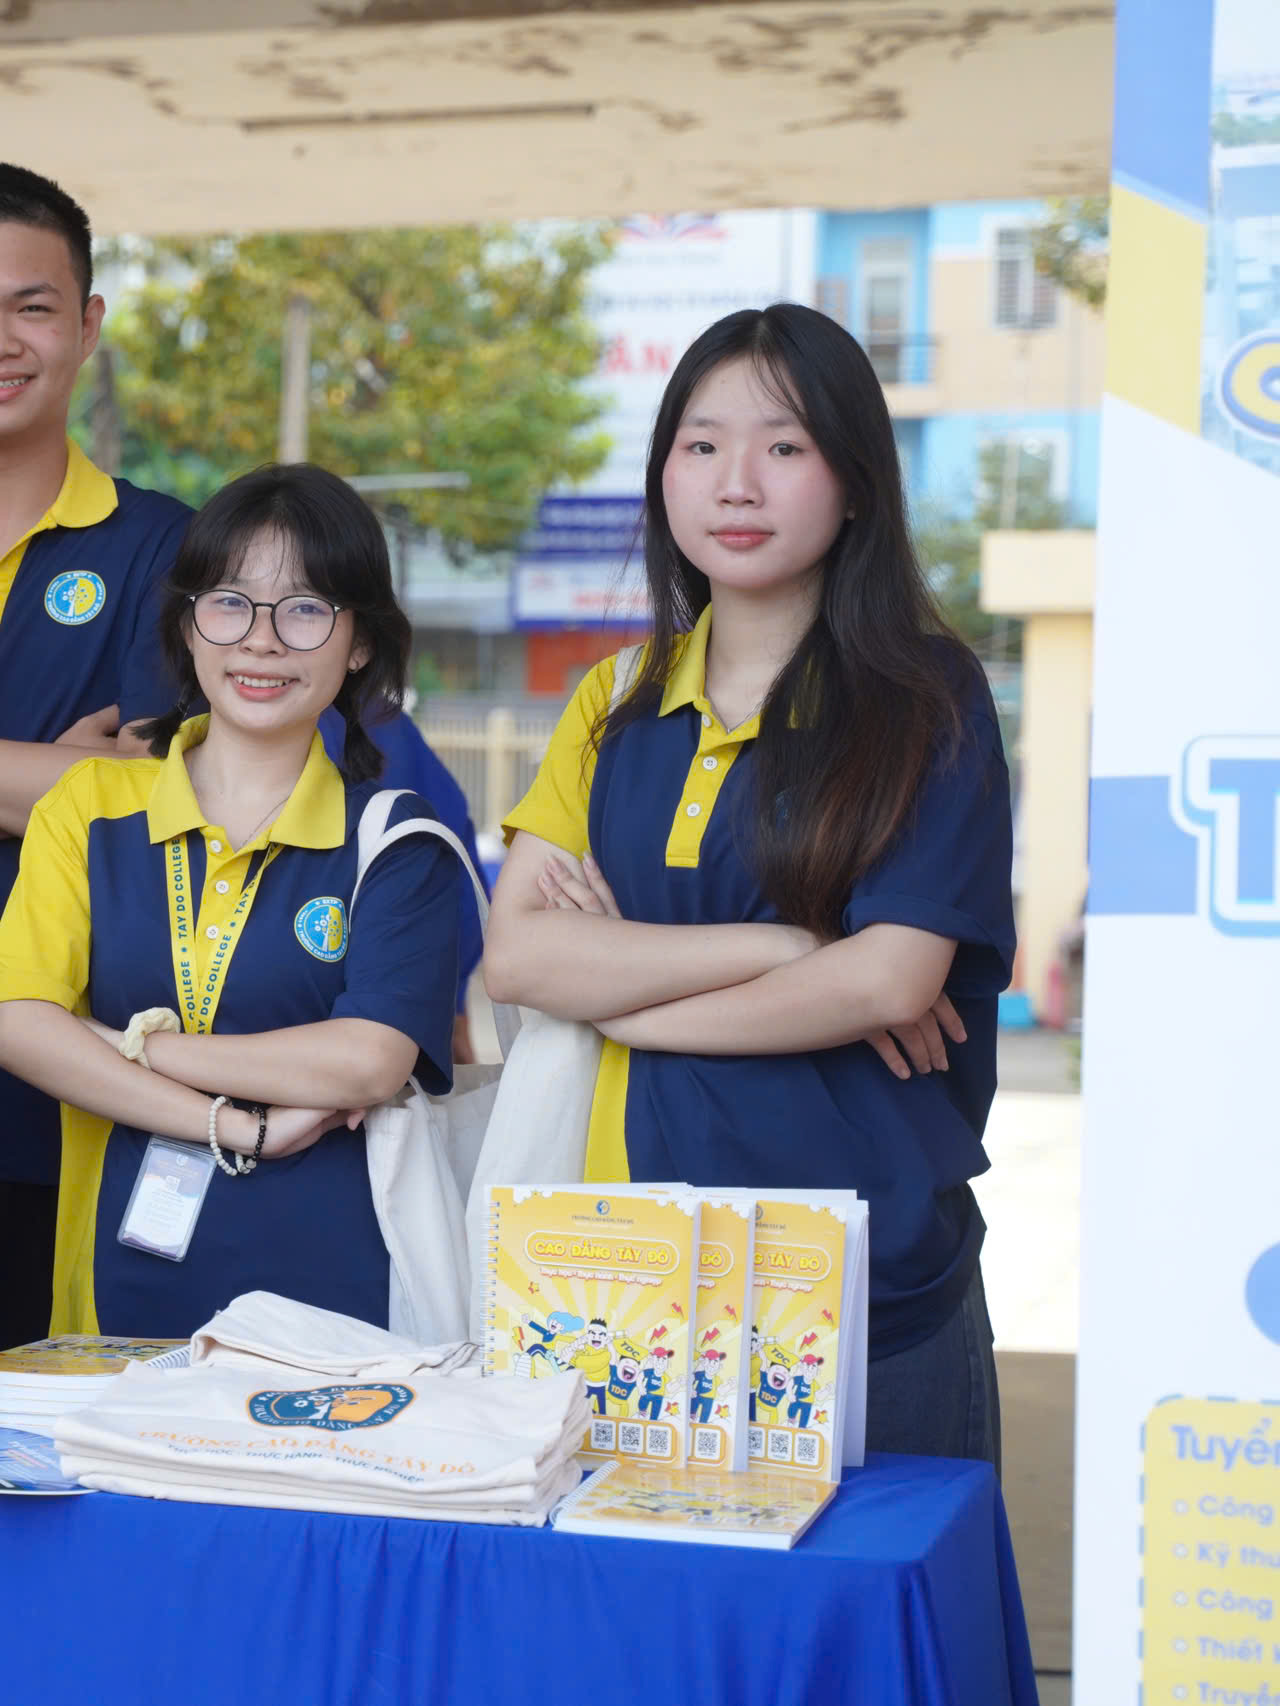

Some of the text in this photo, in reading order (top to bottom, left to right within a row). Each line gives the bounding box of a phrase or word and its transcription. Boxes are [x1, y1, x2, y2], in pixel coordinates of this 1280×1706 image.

[171, 838, 184, 891] COLLEGE
[176, 895, 186, 912] DO
[234, 892, 249, 914] TAY
[177, 916, 188, 939] TAY
[205, 934, 232, 992] COLLEGE
[200, 996, 212, 1016] DO
[535, 1239, 669, 1265] CAO ĐẲNG TÂY ĐÔ
[769, 1251, 793, 1269] TÂY
[799, 1255, 821, 1272] ĐÔ
[619, 1341, 641, 1358] TDC
[771, 1347, 791, 1364] TDC
[611, 1384, 627, 1397] TDC
[760, 1391, 777, 1404] TDC
[1197, 1494, 1274, 1527] Công
[1197, 1587, 1274, 1622] Công
